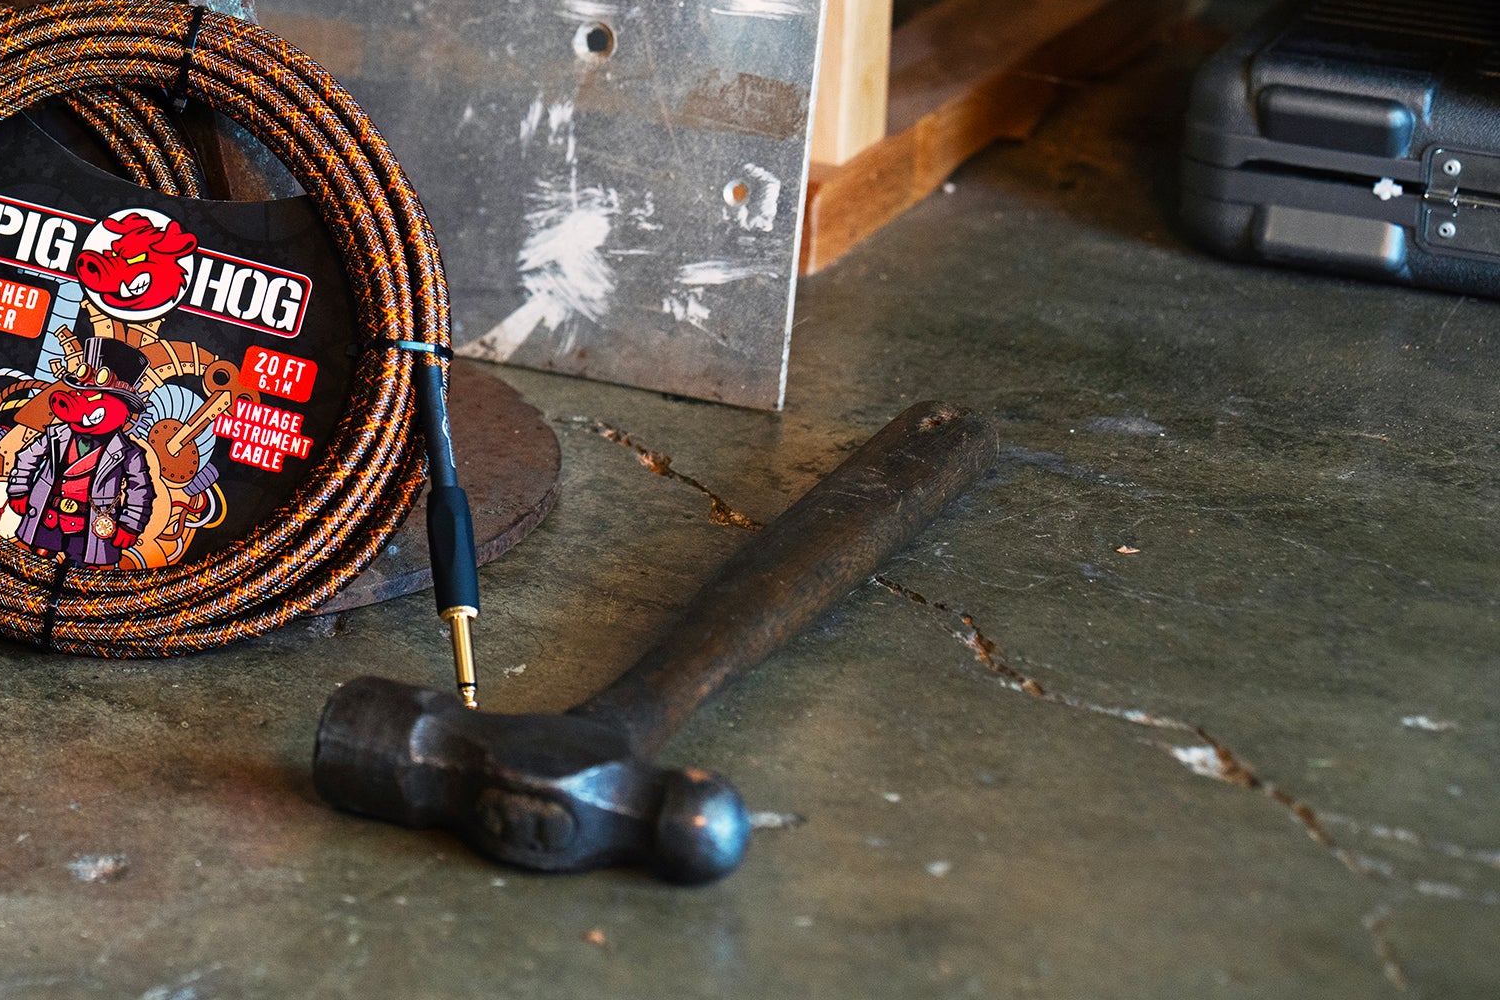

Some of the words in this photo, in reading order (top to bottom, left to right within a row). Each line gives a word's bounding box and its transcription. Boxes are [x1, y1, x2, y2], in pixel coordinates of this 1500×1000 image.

[189, 257, 304, 332] HOG
[253, 351, 280, 376] 20
[282, 358, 307, 383] FT
[258, 373, 280, 392] 6.1
[281, 380, 293, 395] M
[236, 400, 301, 433] VINTAGE
[215, 415, 311, 457] INSTRUMENT
[231, 441, 283, 470] CABLE
